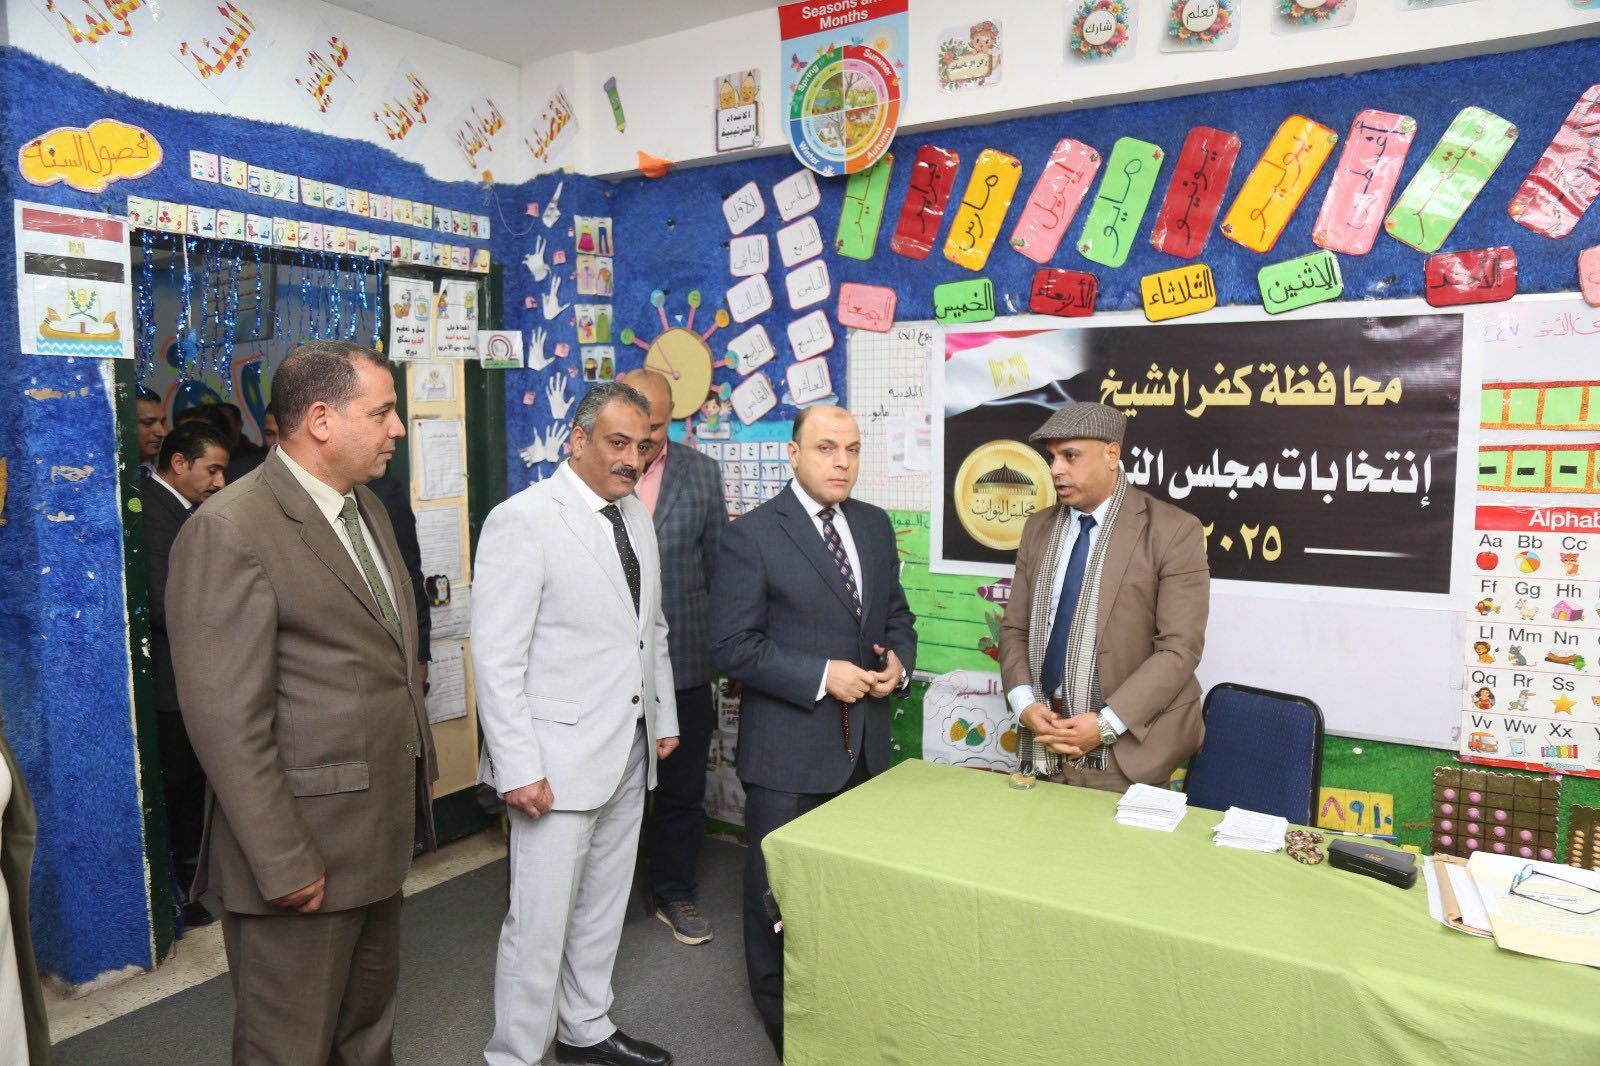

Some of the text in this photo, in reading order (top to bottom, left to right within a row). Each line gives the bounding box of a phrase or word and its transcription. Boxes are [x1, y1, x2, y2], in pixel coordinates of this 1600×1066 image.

[802, 0, 858, 19] Seasons
[820, 9, 869, 30] Months
[1185, 5, 1215, 21] تعلم
[1084, 21, 1113, 35] شارك
[863, 49, 894, 77] Summer
[798, 64, 820, 92] Spring
[87, 131, 150, 177] فصول
[799, 140, 821, 165] Winter
[866, 126, 892, 161] Autumn
[1176, 145, 1217, 246] يونيو
[1250, 136, 1313, 242] يوليو
[959, 174, 999, 252] مارس
[1098, 158, 1143, 259] مايو
[934, 281, 994, 319] الخميس
[1148, 269, 1214, 306] الثلاثاء
[1100, 360, 1403, 418] محافظة كفر الشيخ
[1125, 445, 1433, 508] إنتخابات مجلس الن
[971, 498, 1036, 523] مجلس النواب
[1202, 521, 1283, 562] ٢٠٢٥
[1479, 533, 1588, 551] Aa Bb Cc
[1480, 580, 1582, 599] Ff Gg Hh
[1508, 627, 1543, 643] Mm
[1553, 630, 1579, 645] Nn
[1471, 670, 1576, 692] Qq Rr Ss
[1471, 715, 1573, 739] Vv Ww Xx
[1320, 795, 1347, 822] ٨
[1349, 799, 1365, 826] ٩
